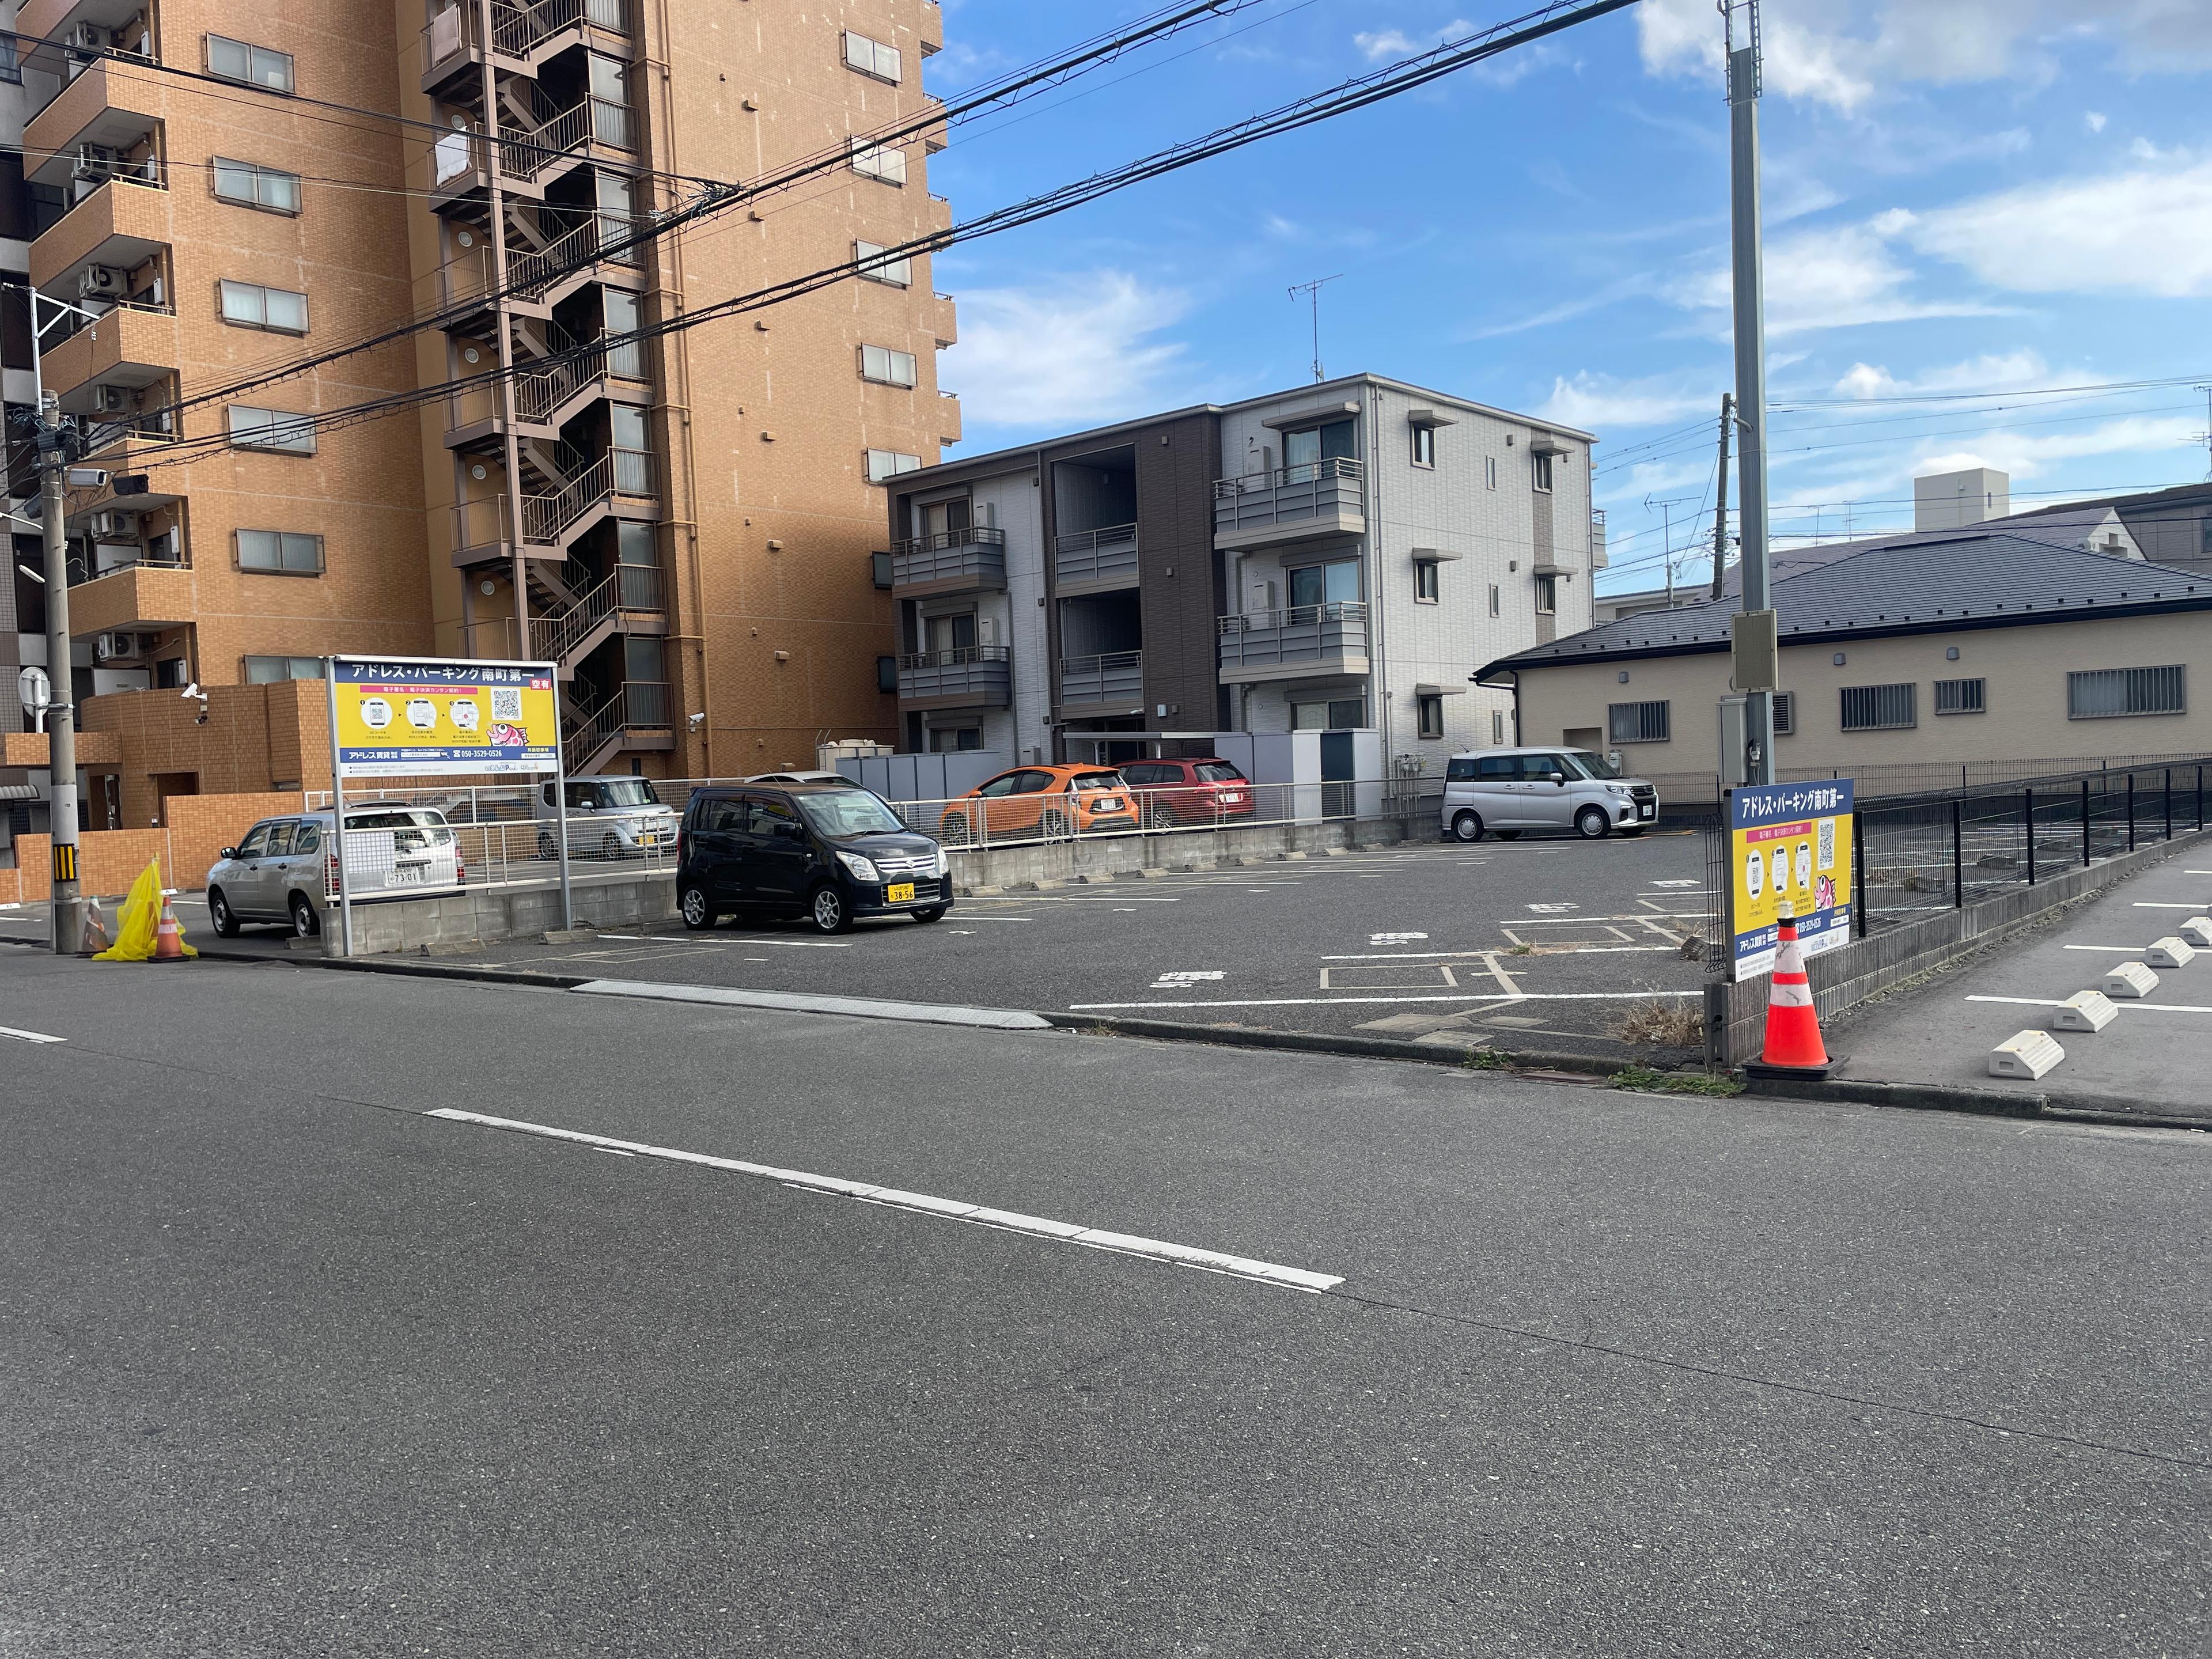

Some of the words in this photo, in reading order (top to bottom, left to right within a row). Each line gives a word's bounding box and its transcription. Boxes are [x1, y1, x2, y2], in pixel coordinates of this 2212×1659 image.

[351, 664, 535, 682] アドレス・パーキング南町第一
[531, 680, 550, 689] 空有
[461, 749, 502, 757] 050-3529-0526
[1742, 787, 1844, 819] アドレス・パーキング南町第一
